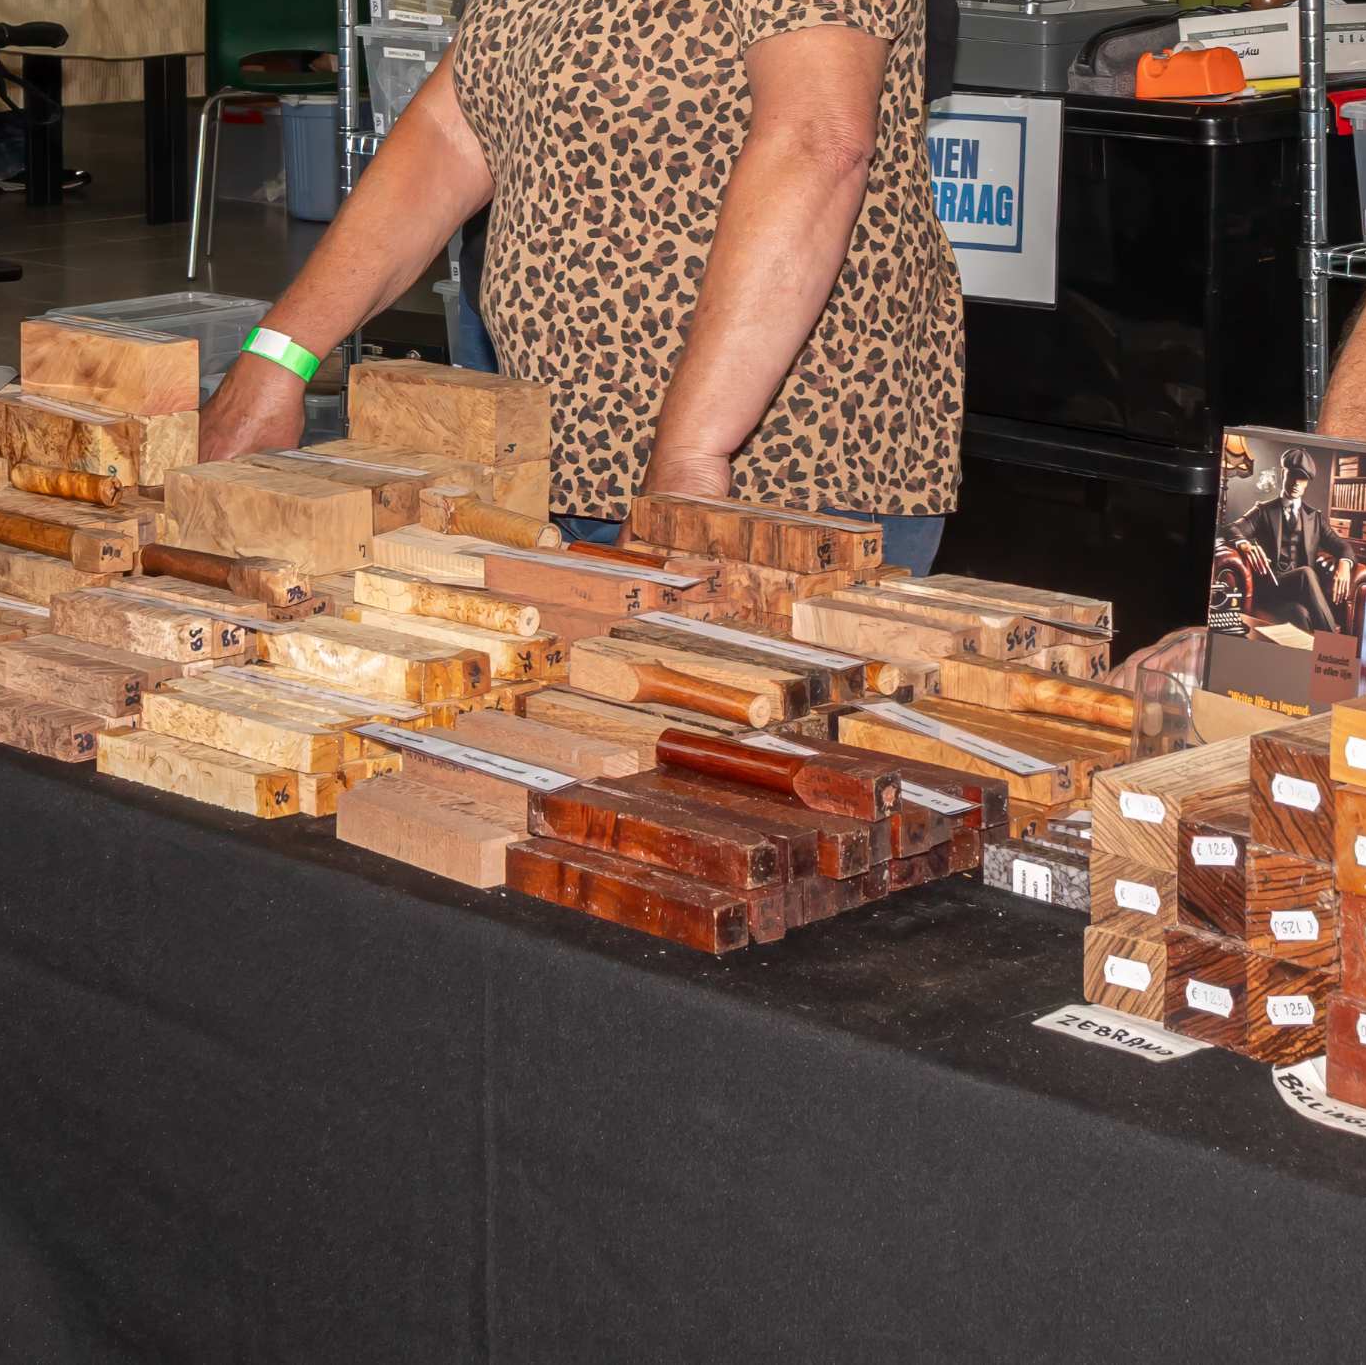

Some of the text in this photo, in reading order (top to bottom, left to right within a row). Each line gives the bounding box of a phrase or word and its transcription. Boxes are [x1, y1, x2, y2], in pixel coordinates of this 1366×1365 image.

[1255, 694, 1271, 710] like
[1272, 702, 1278, 710] a
[274, 786, 290, 806] 26
[1056, 1014, 1173, 1056] ZEBRANO
